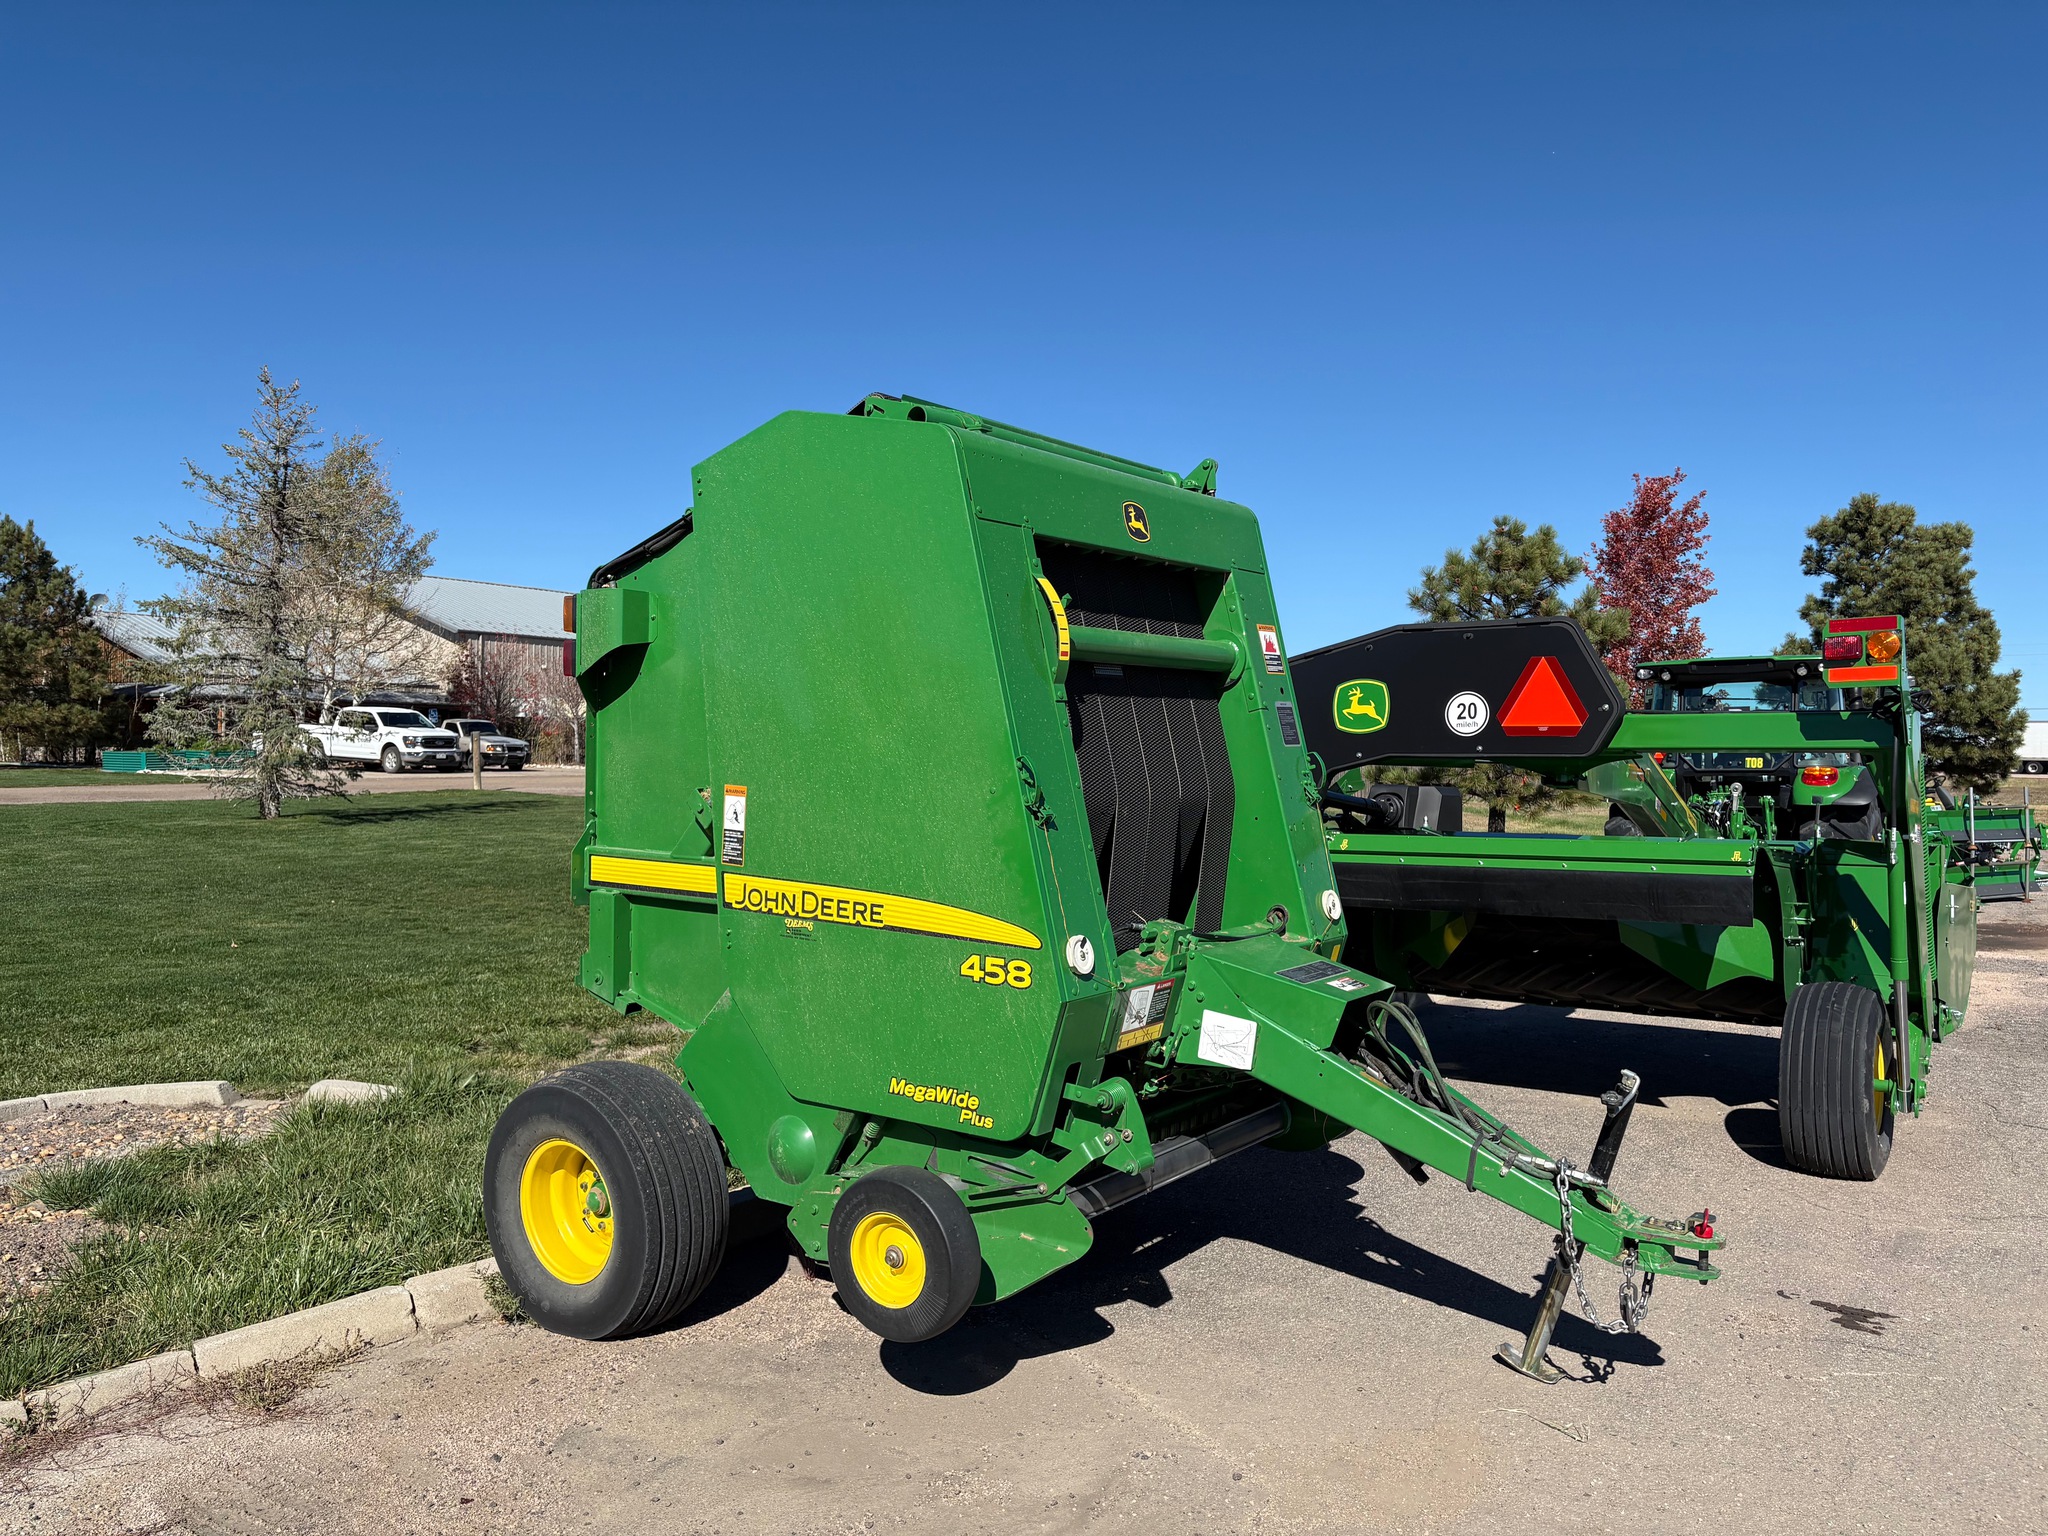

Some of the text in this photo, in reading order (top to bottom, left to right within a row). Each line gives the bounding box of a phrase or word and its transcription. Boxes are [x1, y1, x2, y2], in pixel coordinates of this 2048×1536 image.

[1457, 702, 1478, 720] 20
[1456, 720, 1479, 728] mile/h
[734, 883, 885, 924] JOHN DEERE
[784, 918, 814, 932] DEEMS
[960, 954, 1032, 989] 458
[888, 1077, 980, 1111] MegaWide
[958, 1109, 994, 1129] Plus
